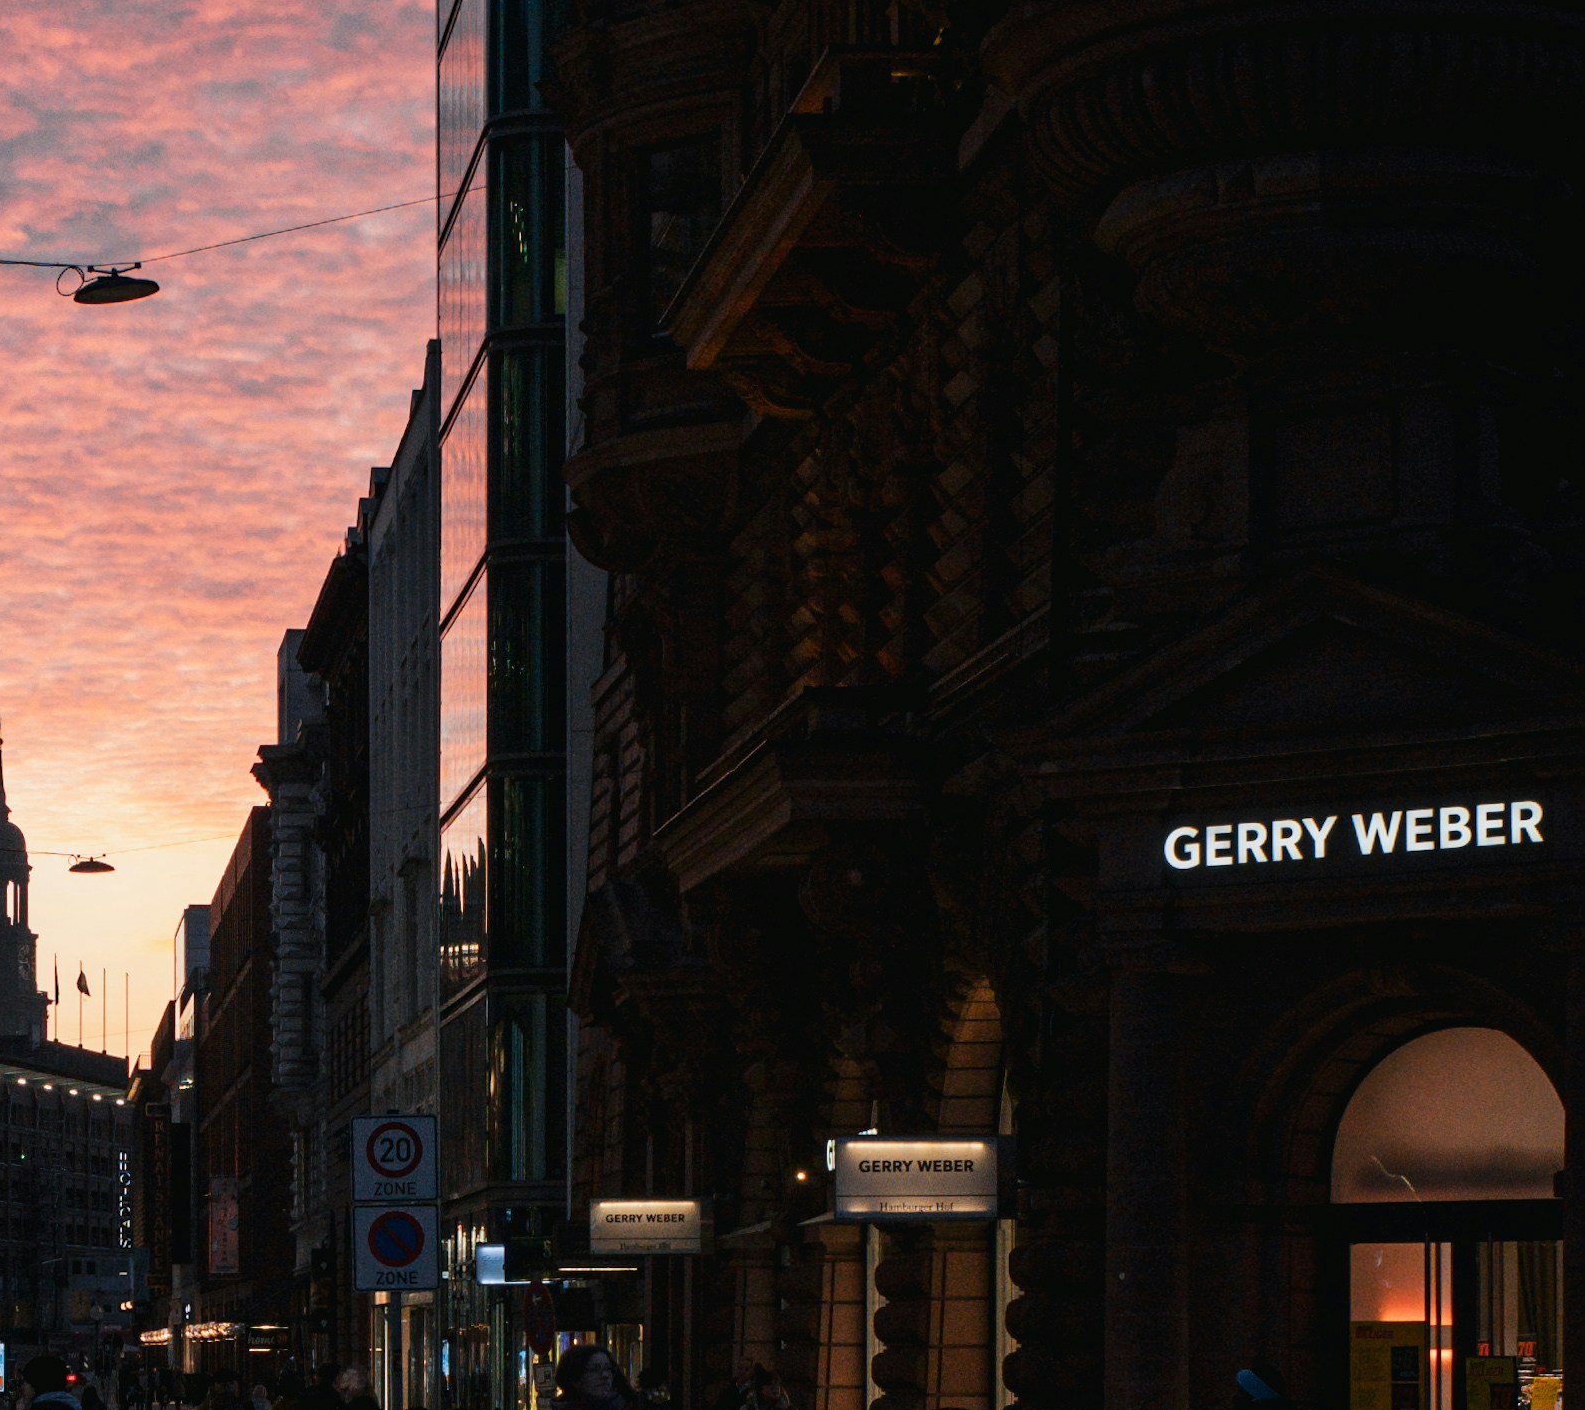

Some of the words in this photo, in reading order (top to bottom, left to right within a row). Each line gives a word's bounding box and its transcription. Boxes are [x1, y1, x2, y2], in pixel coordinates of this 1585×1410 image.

[1163, 813, 1339, 871] GERRY
[1351, 800, 1545, 856] WEBER
[380, 1137, 411, 1163] 20
[859, 1160, 913, 1173] GERRY
[918, 1159, 974, 1172] WEBER
[374, 1182, 417, 1196] ZONE
[605, 1213, 642, 1224] GERRY
[646, 1213, 685, 1224] WEBER
[376, 1271, 419, 1285] ZONE
